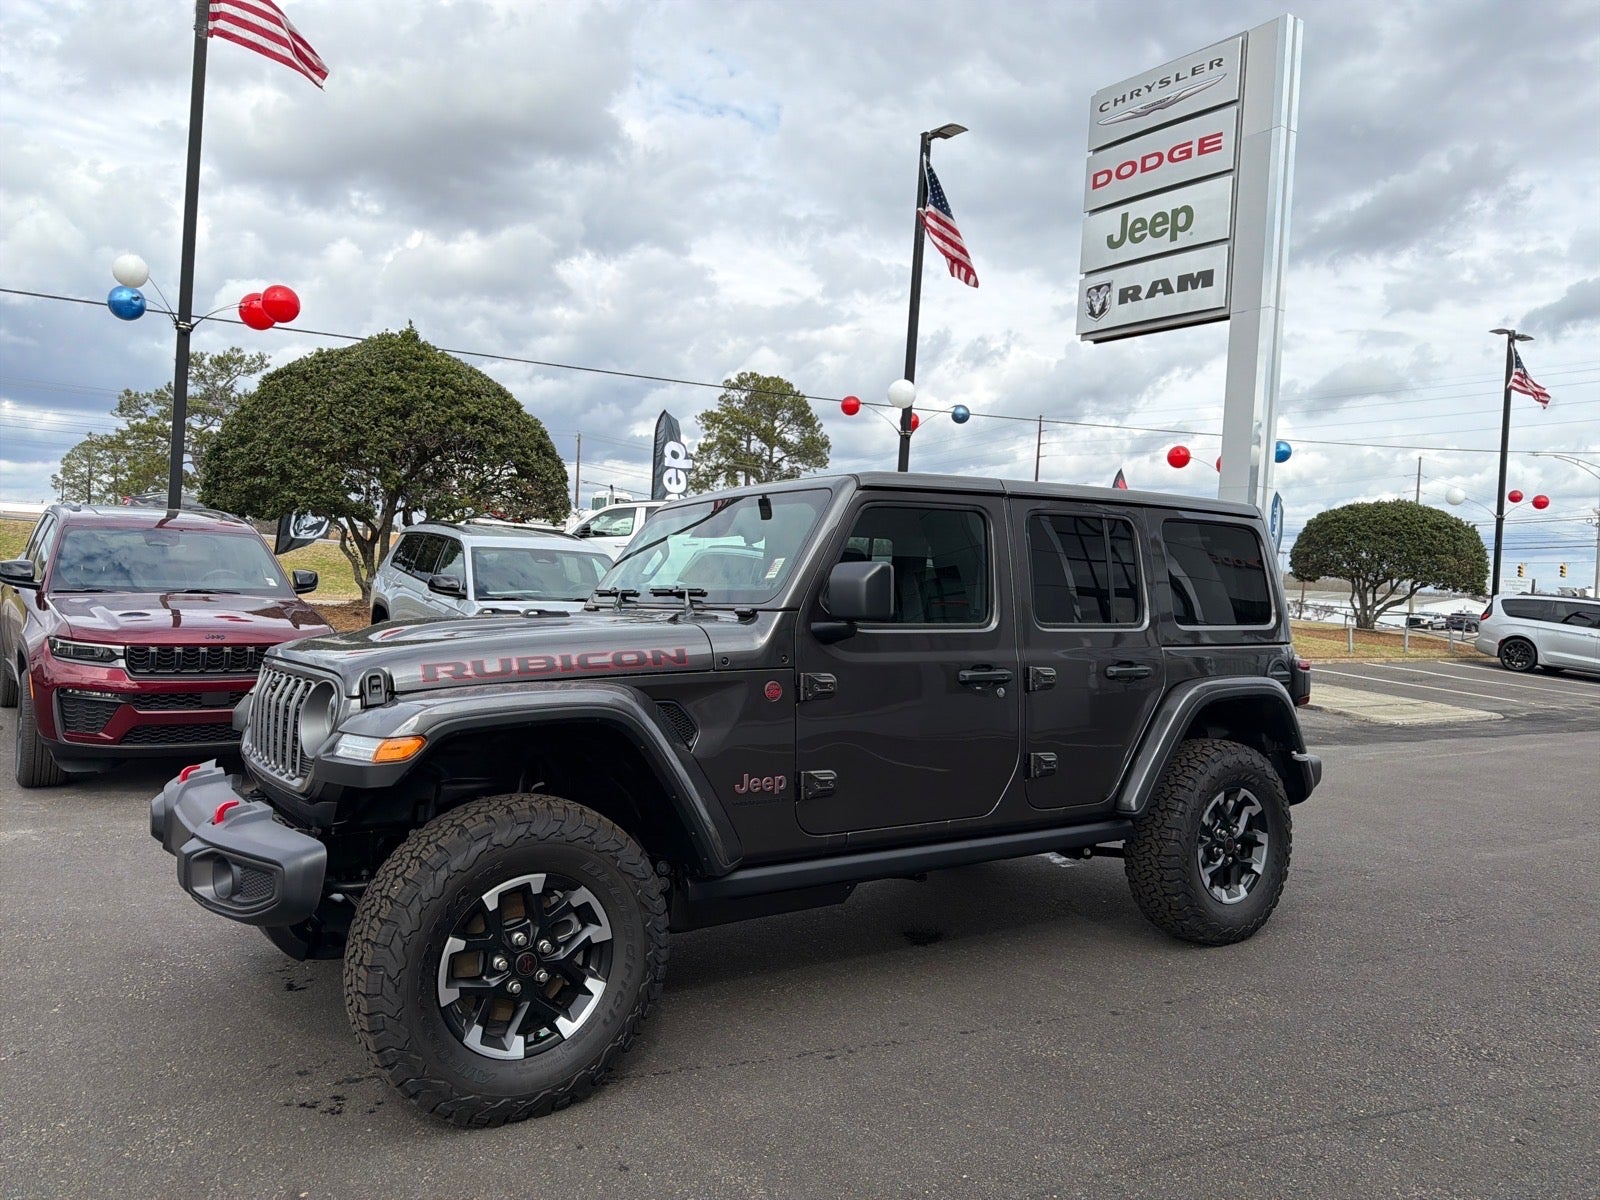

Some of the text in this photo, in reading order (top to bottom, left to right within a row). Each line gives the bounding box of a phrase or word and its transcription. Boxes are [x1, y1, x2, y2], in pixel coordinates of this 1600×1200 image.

[1098, 57, 1224, 113] CHRYSLER
[1091, 131, 1224, 190] DODGE
[1106, 204, 1194, 250] Jeep
[1117, 268, 1215, 306] RAM
[663, 440, 693, 500] ep
[421, 648, 689, 683] RUBICON
[734, 773, 787, 795] Jeep
